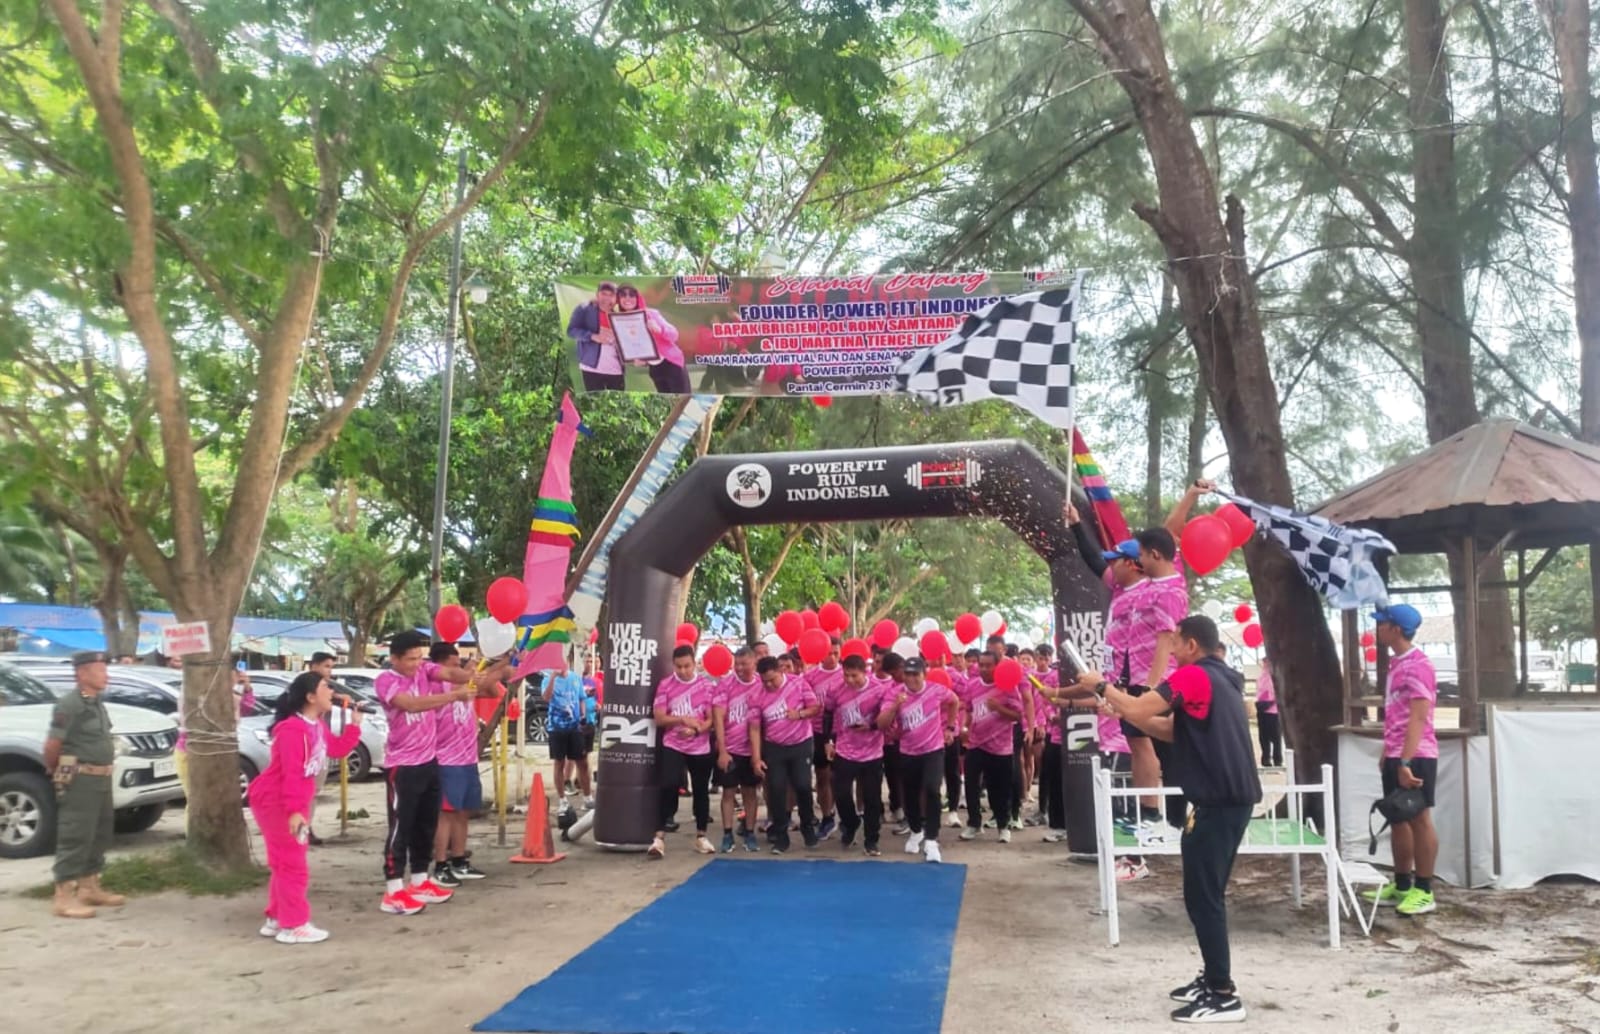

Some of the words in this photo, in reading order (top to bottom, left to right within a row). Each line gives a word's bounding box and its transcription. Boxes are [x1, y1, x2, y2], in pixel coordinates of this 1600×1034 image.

[740, 305, 819, 320] FOUNDER
[822, 302, 890, 318] POWER
[892, 300, 918, 315] FIT
[713, 323, 759, 337] BAPAK
[760, 321, 817, 336] BRIGJEN
[820, 321, 846, 334] POL
[848, 317, 888, 332] RONY
[761, 338, 774, 351] &
[775, 336, 799, 350] IBU
[801, 334, 865, 349] MARTINA
[866, 331, 913, 347] TIENCE
[695, 354, 730, 366] DALAM
[731, 354, 773, 365] RANGKA
[773, 353, 816, 364] VIRTUAL
[817, 352, 840, 362] RUN
[841, 351, 864, 362] DAN
[803, 366, 864, 377] POWERFIT
[786, 382, 823, 394] Pantai
[824, 381, 867, 393] Cermin
[868, 380, 883, 391] 23
[788, 460, 887, 476] POWERFIT
[816, 474, 856, 487] RUN
[786, 485, 890, 501] INDONESIA
[1063, 612, 1103, 631] LIVE
[609, 623, 642, 640] LIVE
[613, 639, 658, 659] YOUR
[610, 654, 649, 671] BEST
[615, 669, 652, 686] LIFE
[601, 716, 656, 748] 24
